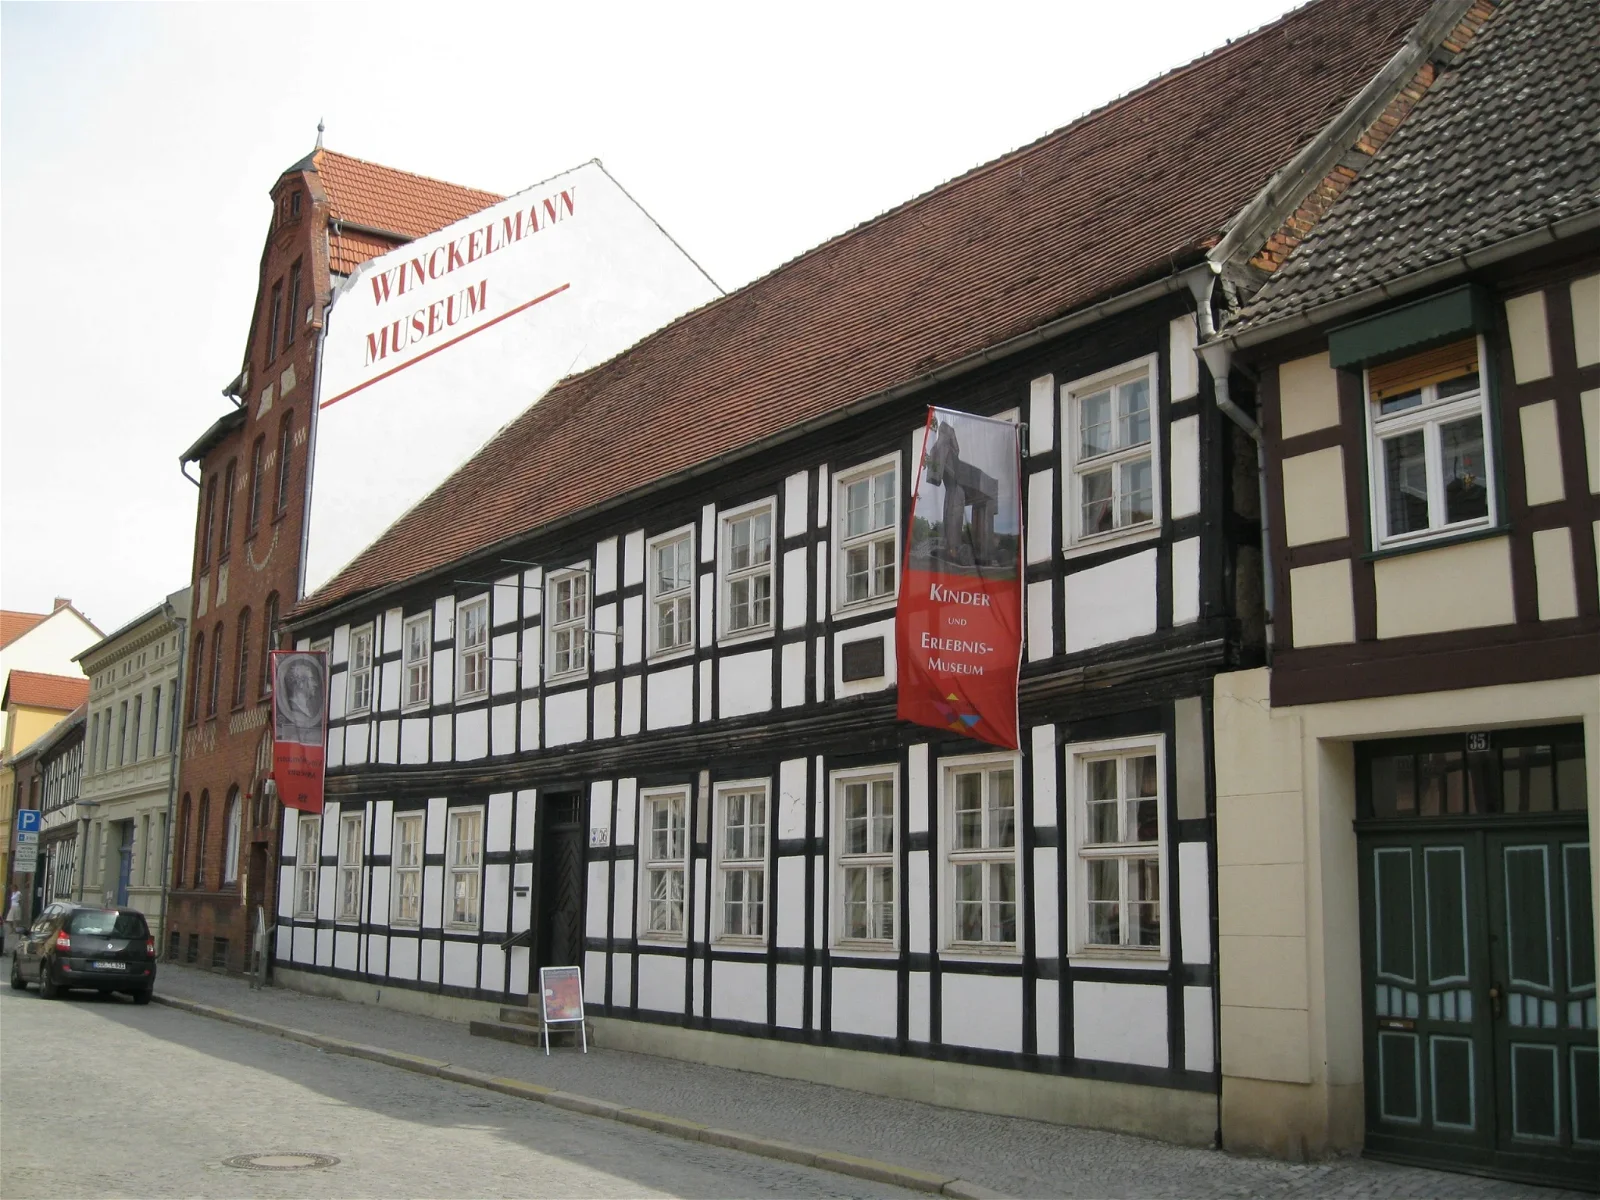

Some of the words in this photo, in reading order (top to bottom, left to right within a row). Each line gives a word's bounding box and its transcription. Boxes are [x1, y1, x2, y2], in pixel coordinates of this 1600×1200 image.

[370, 186, 577, 307] WINCKELMANN
[363, 278, 489, 367] MUSEUM
[929, 582, 990, 607] KINDER
[948, 617, 967, 626] UND
[921, 632, 994, 655] ERLEBNIS-
[928, 656, 984, 676] MUSEUM
[1469, 733, 1486, 749] 35
[22, 812, 36, 829] P
